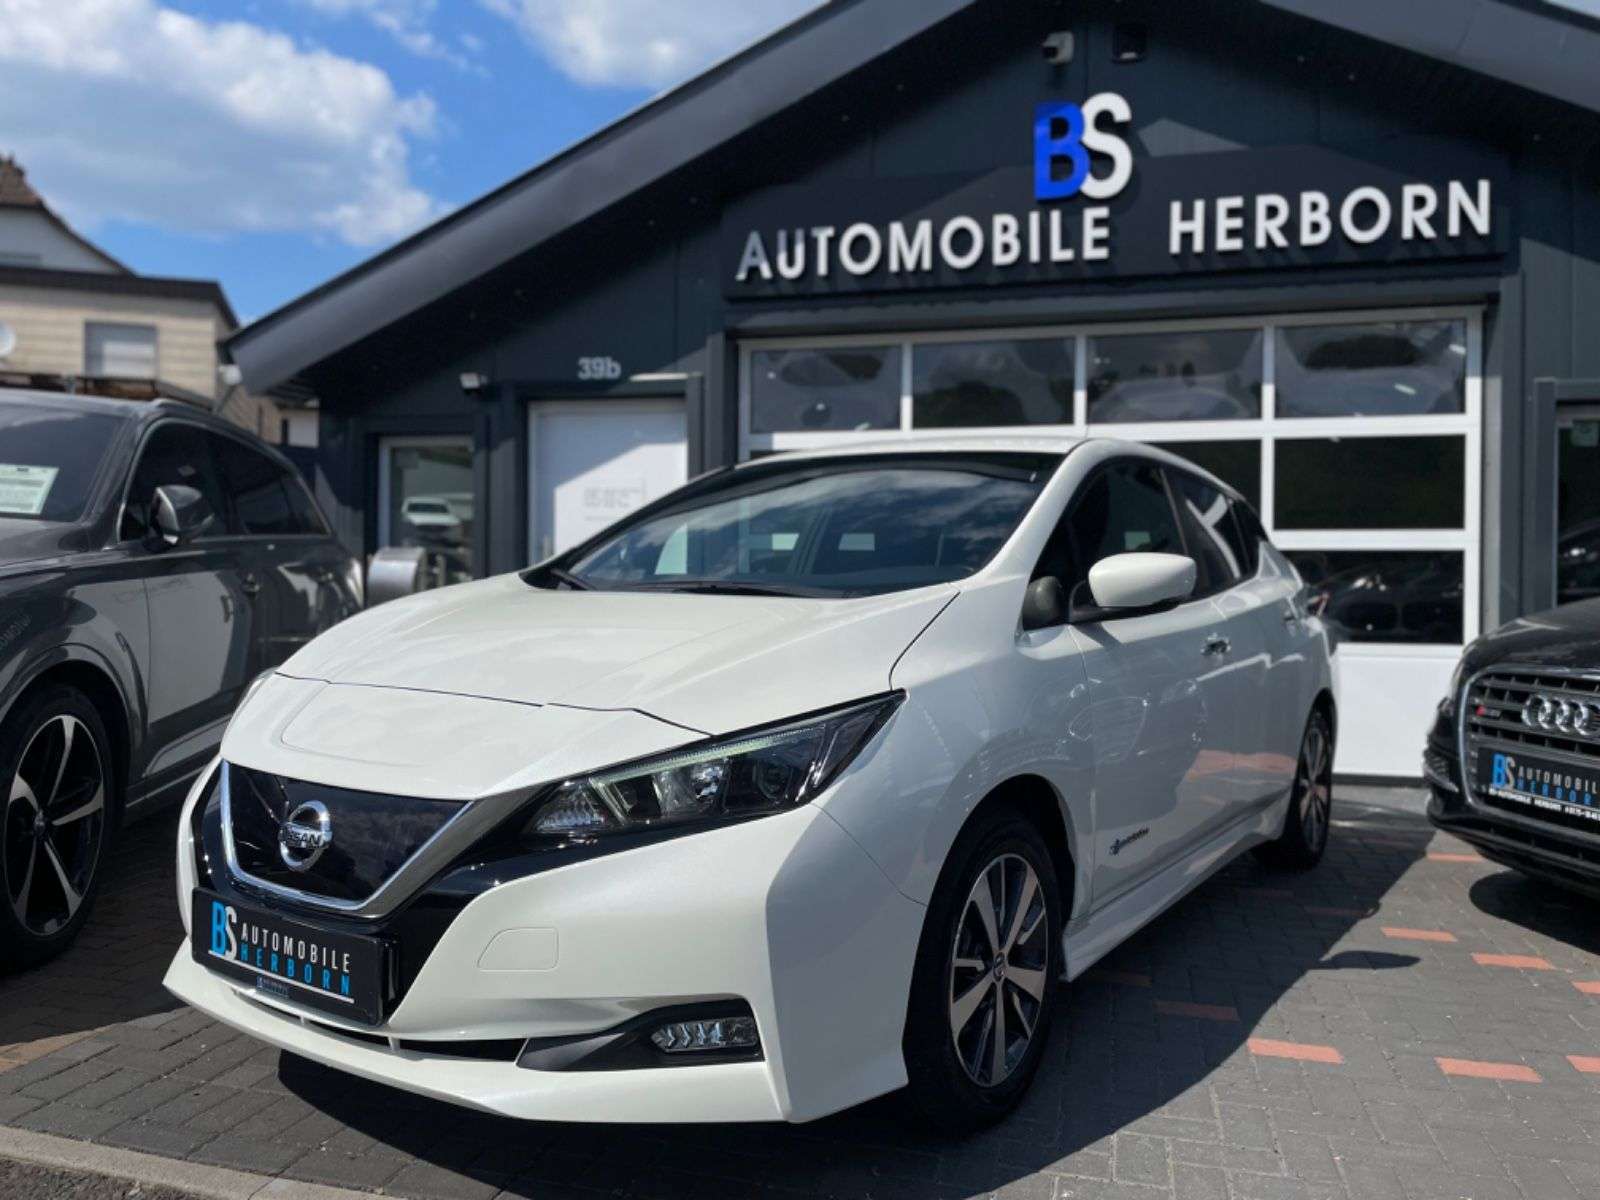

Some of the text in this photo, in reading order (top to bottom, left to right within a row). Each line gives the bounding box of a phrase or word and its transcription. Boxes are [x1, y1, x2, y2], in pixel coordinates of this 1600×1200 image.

[1034, 92, 1133, 201] BS
[736, 179, 1491, 281] AUTOMOBILE HERBORN
[578, 356, 621, 379] 39b
[211, 900, 237, 960] BS
[240, 922, 350, 974] AUTOMOBILE
[240, 942, 351, 995] HERBORN
